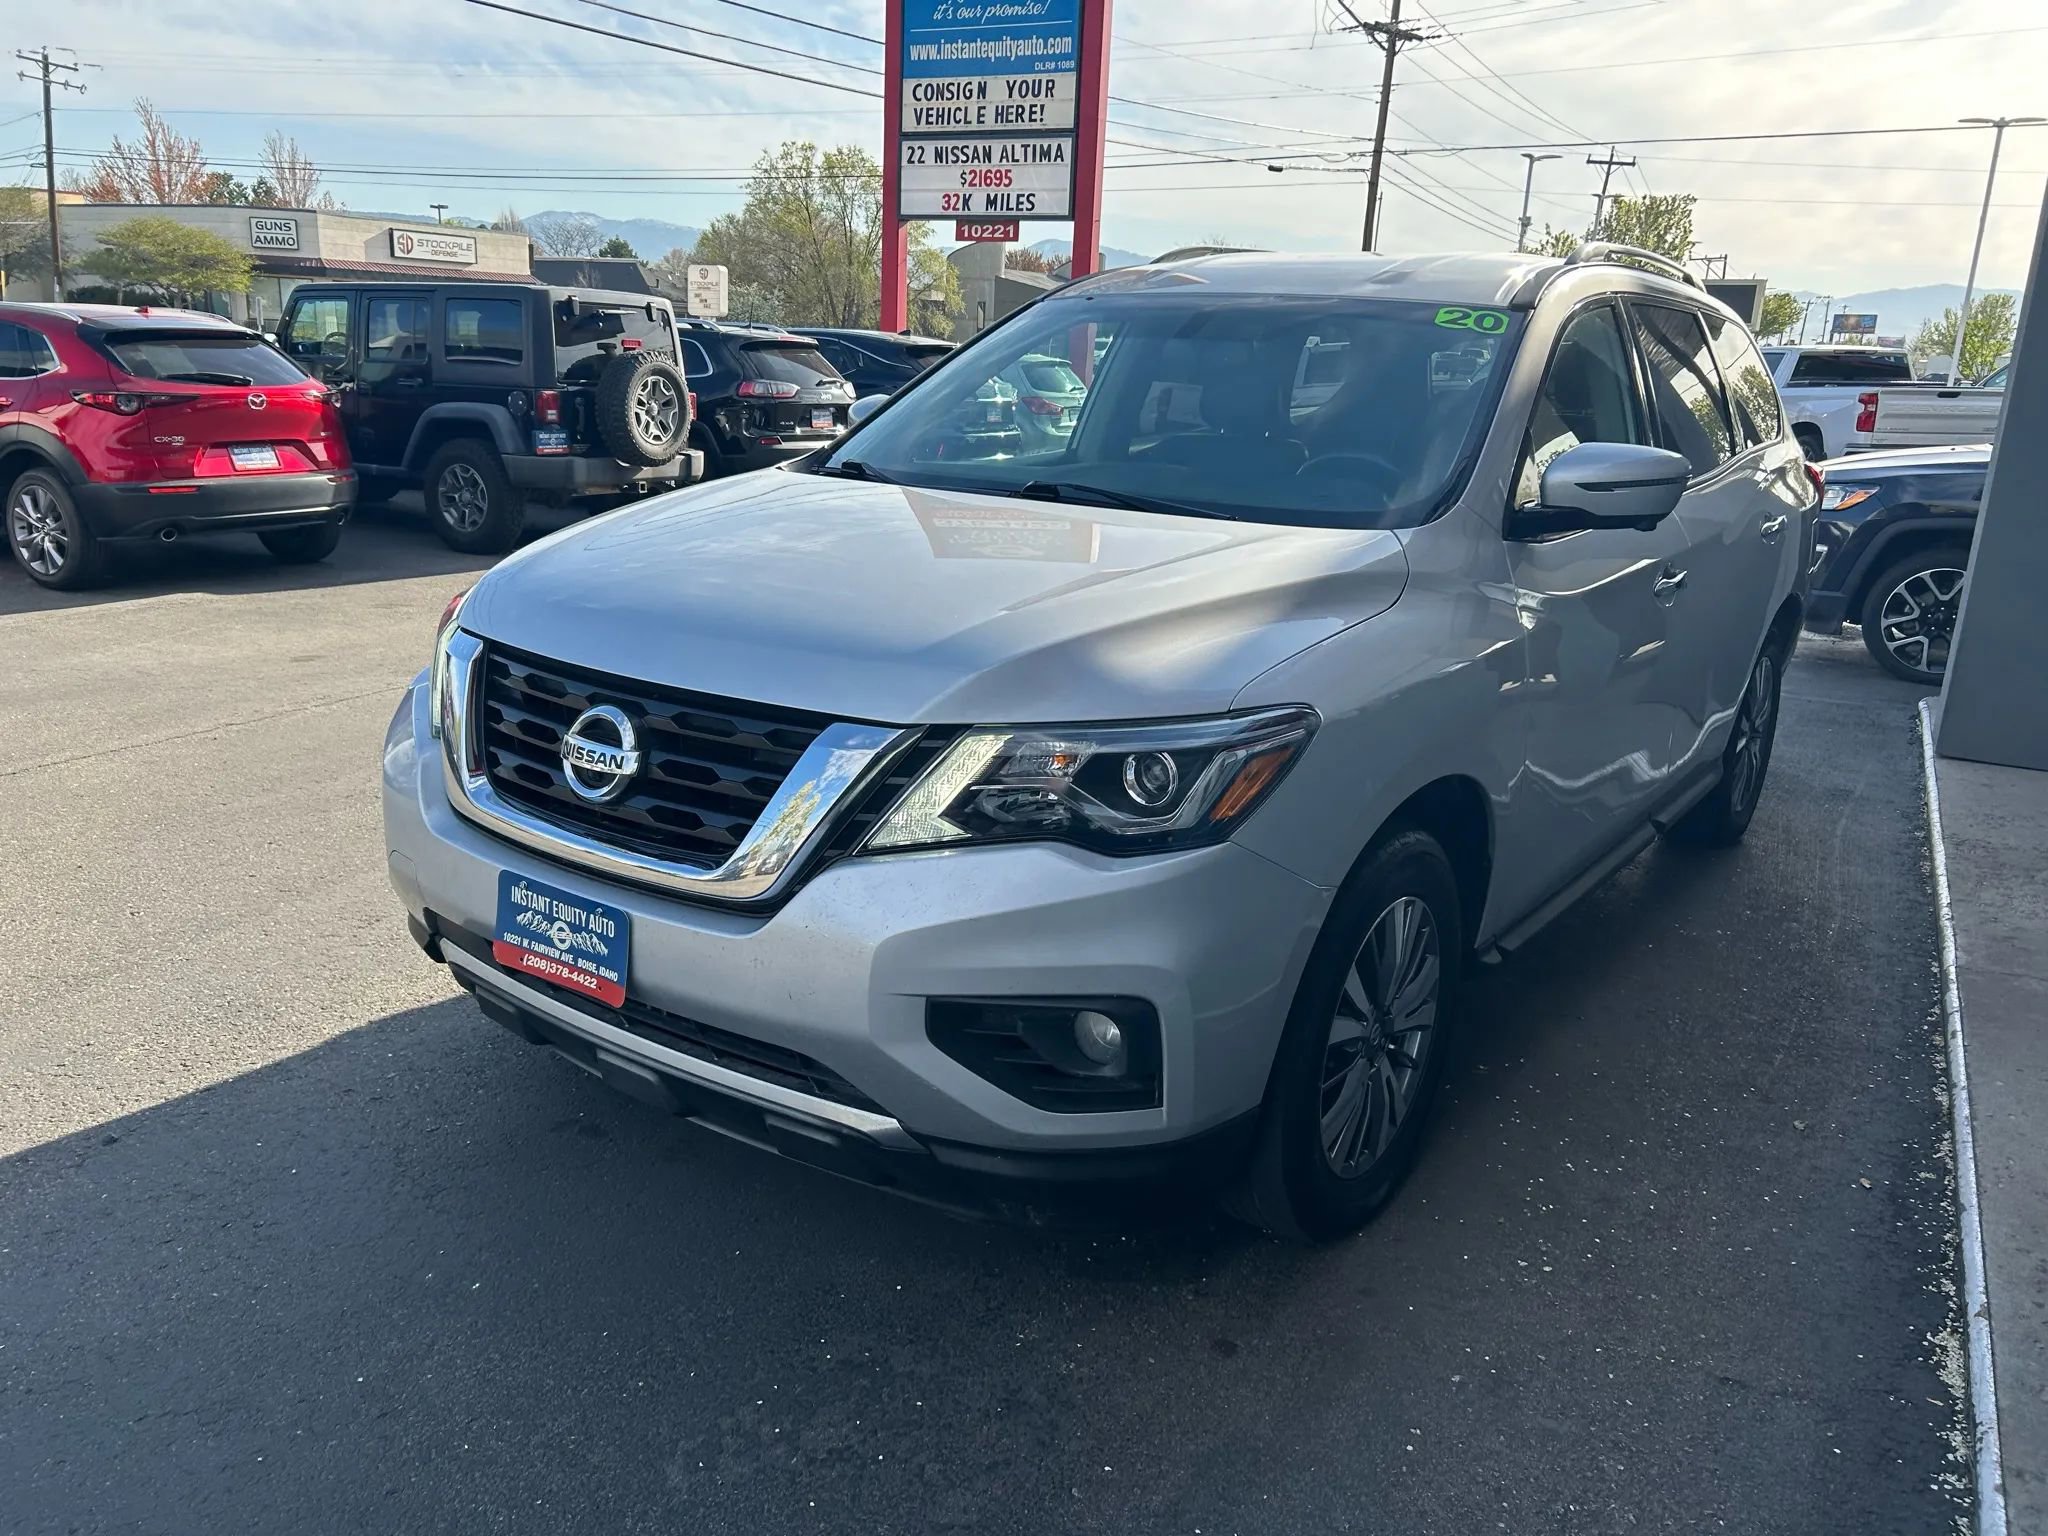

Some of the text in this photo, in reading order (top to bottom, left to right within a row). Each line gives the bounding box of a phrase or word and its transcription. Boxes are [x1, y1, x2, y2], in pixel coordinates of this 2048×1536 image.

[933, 1, 1050, 24] it's our promise!
[910, 35, 1072, 62] www.instantequityauto.com
[1035, 62, 1055, 71] DLR#
[912, 79, 1055, 102] CONSIGN YOUR
[914, 104, 1045, 126] VEHICLE HERE!
[907, 143, 1064, 164] 22 NISSAN ALTIMA
[960, 169, 1013, 188] $21695
[941, 193, 1036, 211] 32K MILES
[255, 221, 292, 232] GUNS
[961, 225, 1015, 238] 10221
[254, 235, 296, 246] AMMO
[417, 239, 472, 252] STOCKPILE
[430, 249, 459, 257] DEFENSE
[1438, 309, 1504, 332] 20
[154, 435, 185, 443] CX-30
[561, 741, 624, 770] NISSAN
[511, 885, 615, 938] INSTANT EQUITY AUTO
[503, 932, 619, 982] 10221 W. FAIRVIEW AVE. BOISE, IDAHO
[523, 953, 598, 990] (208)378-4422
